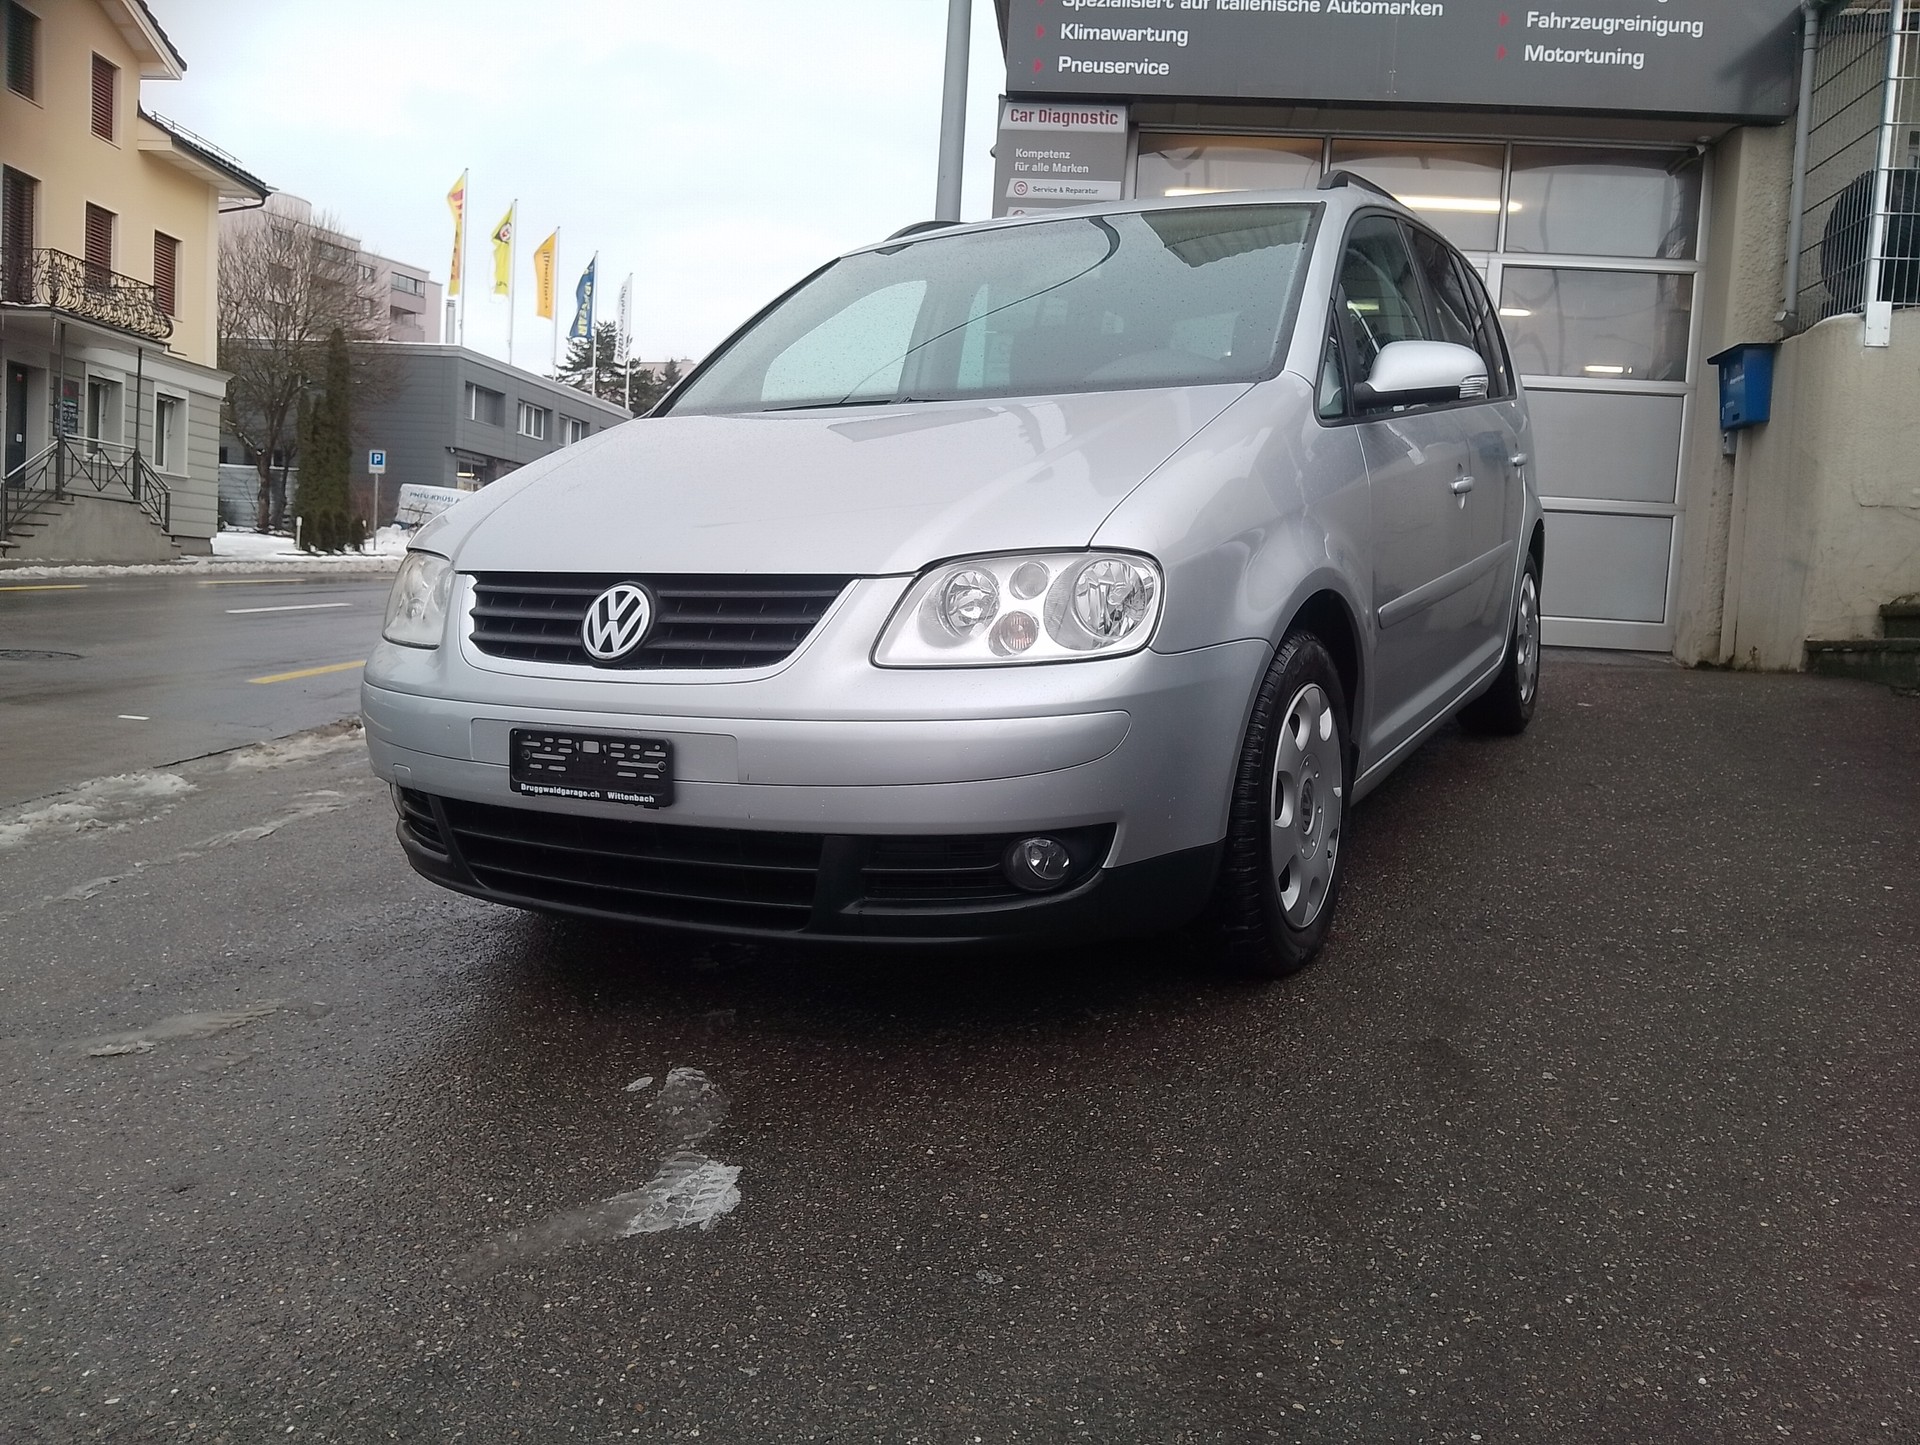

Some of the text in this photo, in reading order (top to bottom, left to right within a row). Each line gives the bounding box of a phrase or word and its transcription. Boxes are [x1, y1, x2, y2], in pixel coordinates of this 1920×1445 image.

[1179, 0, 1210, 10] auf
[1326, 0, 1443, 16] Automarken
[1526, 11, 1704, 38] Fahrzeugreinigung
[1060, 23, 1189, 47] Klimawartung
[1058, 56, 1170, 75] Pneuservice
[1524, 44, 1645, 70] Motortuning
[1010, 108, 1119, 127] Car Diagnostic
[1015, 148, 1071, 160] Kompetenz
[1014, 162, 1089, 173] für alle Marken
[1032, 186, 1058, 194] Service
[1065, 187, 1099, 195] Reparatur
[583, 585, 650, 659] VW
[607, 791, 655, 803] Wittenbach
